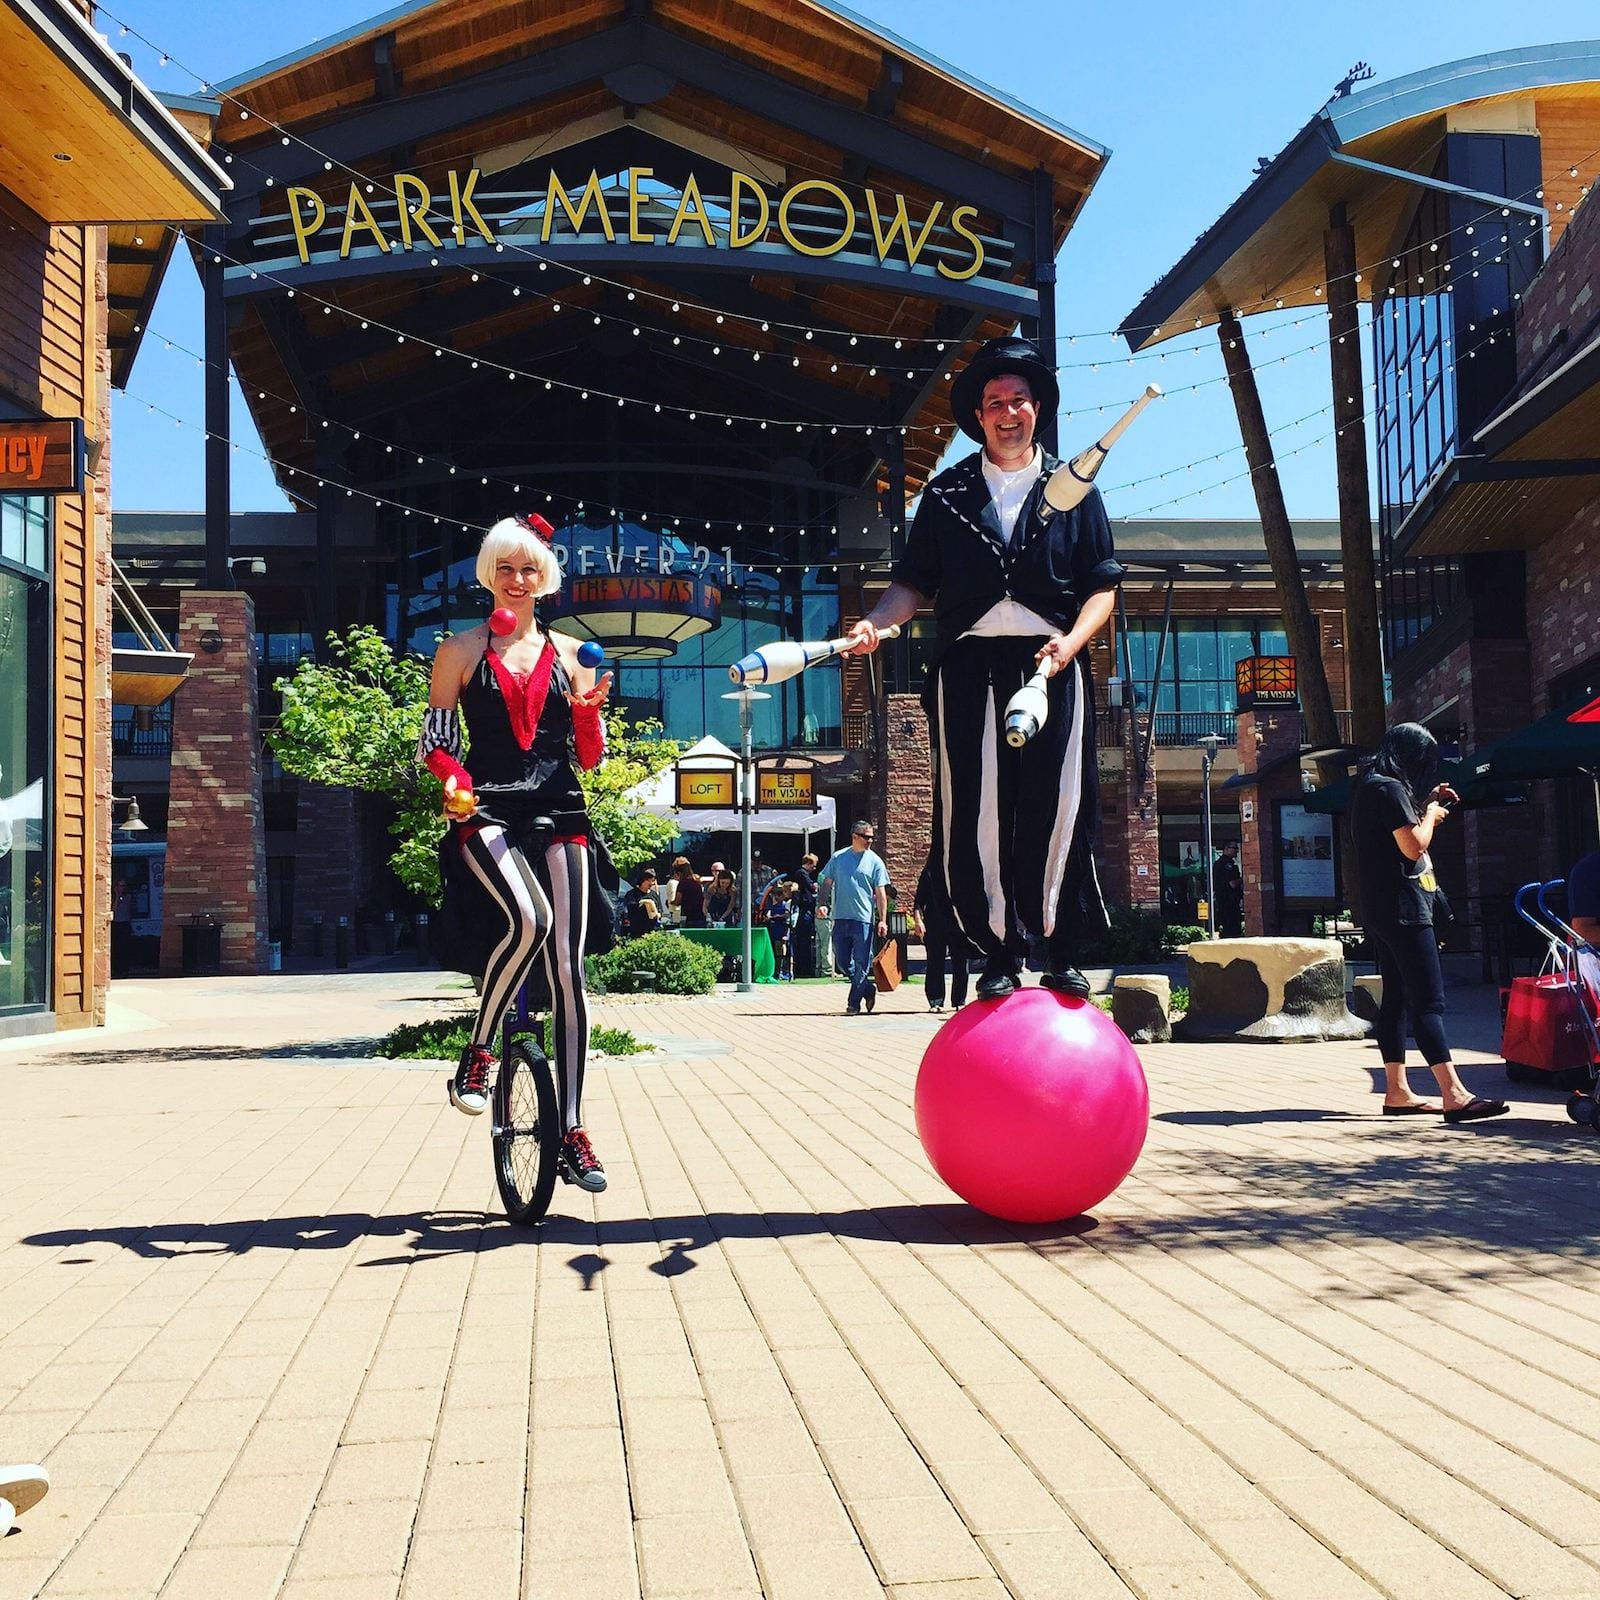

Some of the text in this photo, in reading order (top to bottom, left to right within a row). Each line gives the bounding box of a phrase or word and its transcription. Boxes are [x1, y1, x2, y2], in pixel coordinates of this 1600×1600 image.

[287, 166, 985, 281] PARK MEADOWS
[0, 435, 48, 480] cy
[617, 578, 693, 602] VISTAS
[1270, 690, 1297, 699] VISTAS
[690, 783, 723, 795] LOFT
[780, 788, 811, 798] VISTAS
